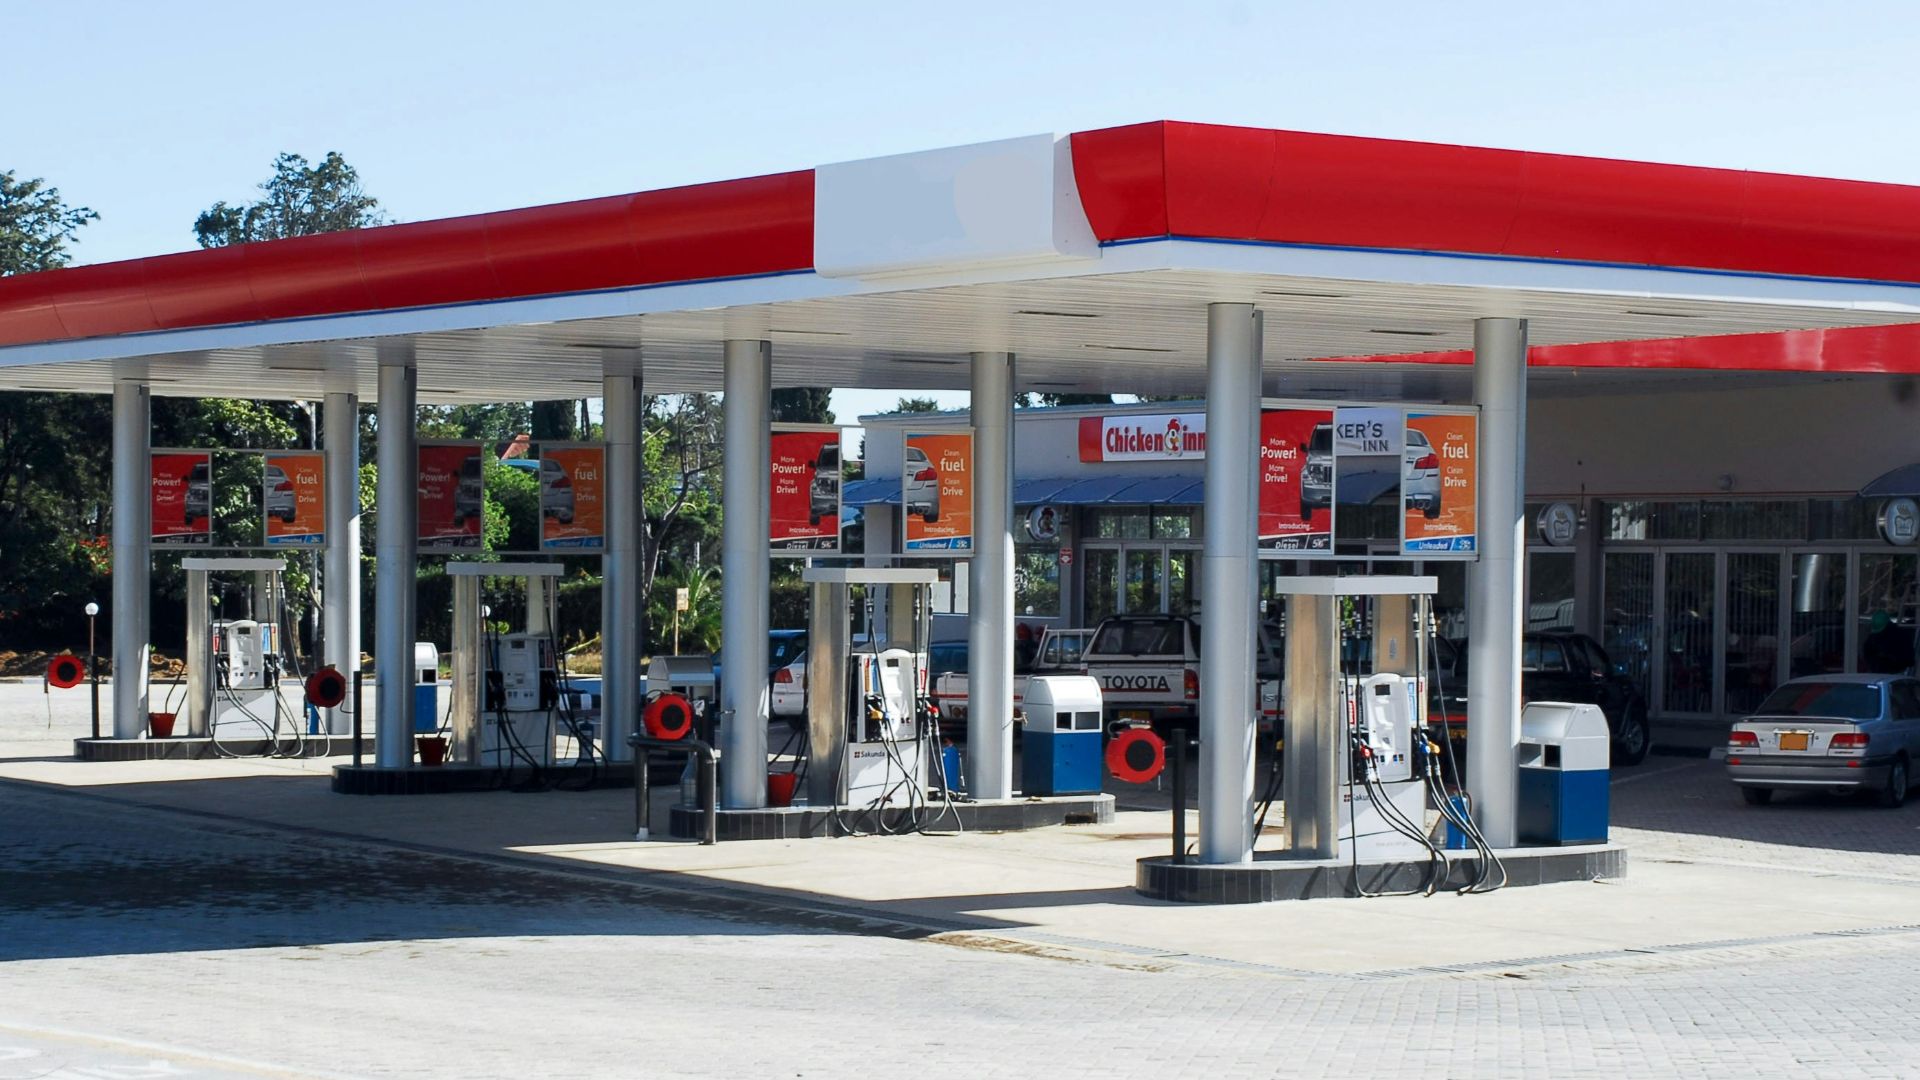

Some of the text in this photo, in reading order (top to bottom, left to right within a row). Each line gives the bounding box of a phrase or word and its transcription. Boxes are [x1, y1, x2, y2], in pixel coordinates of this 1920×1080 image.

[1106, 425, 1206, 453] Chicken inn
[1446, 432, 1464, 440] Clean
[1270, 438, 1286, 446] More
[1363, 440, 1389, 452] INN
[1260, 446, 1297, 460] Power!
[1442, 442, 1469, 458] fuel
[772, 462, 806, 474] Power!
[940, 458, 966, 472] fuel
[1268, 464, 1285, 472] More
[1446, 466, 1464, 474] Clean
[296, 473, 318, 484] fuel
[420, 472, 450, 482] Power!
[574, 468, 597, 480] fuel
[1264, 472, 1288, 482] Drive!
[152, 477, 181, 487] Power!
[1444, 476, 1467, 487] Drive
[776, 485, 798, 494] Drive!
[942, 486, 964, 496] Drive
[576, 492, 596, 501] Drive
[1275, 540, 1299, 549] Diesel
[1102, 675, 1169, 689] TOYOTA
[861, 750, 885, 758] Sakunda
